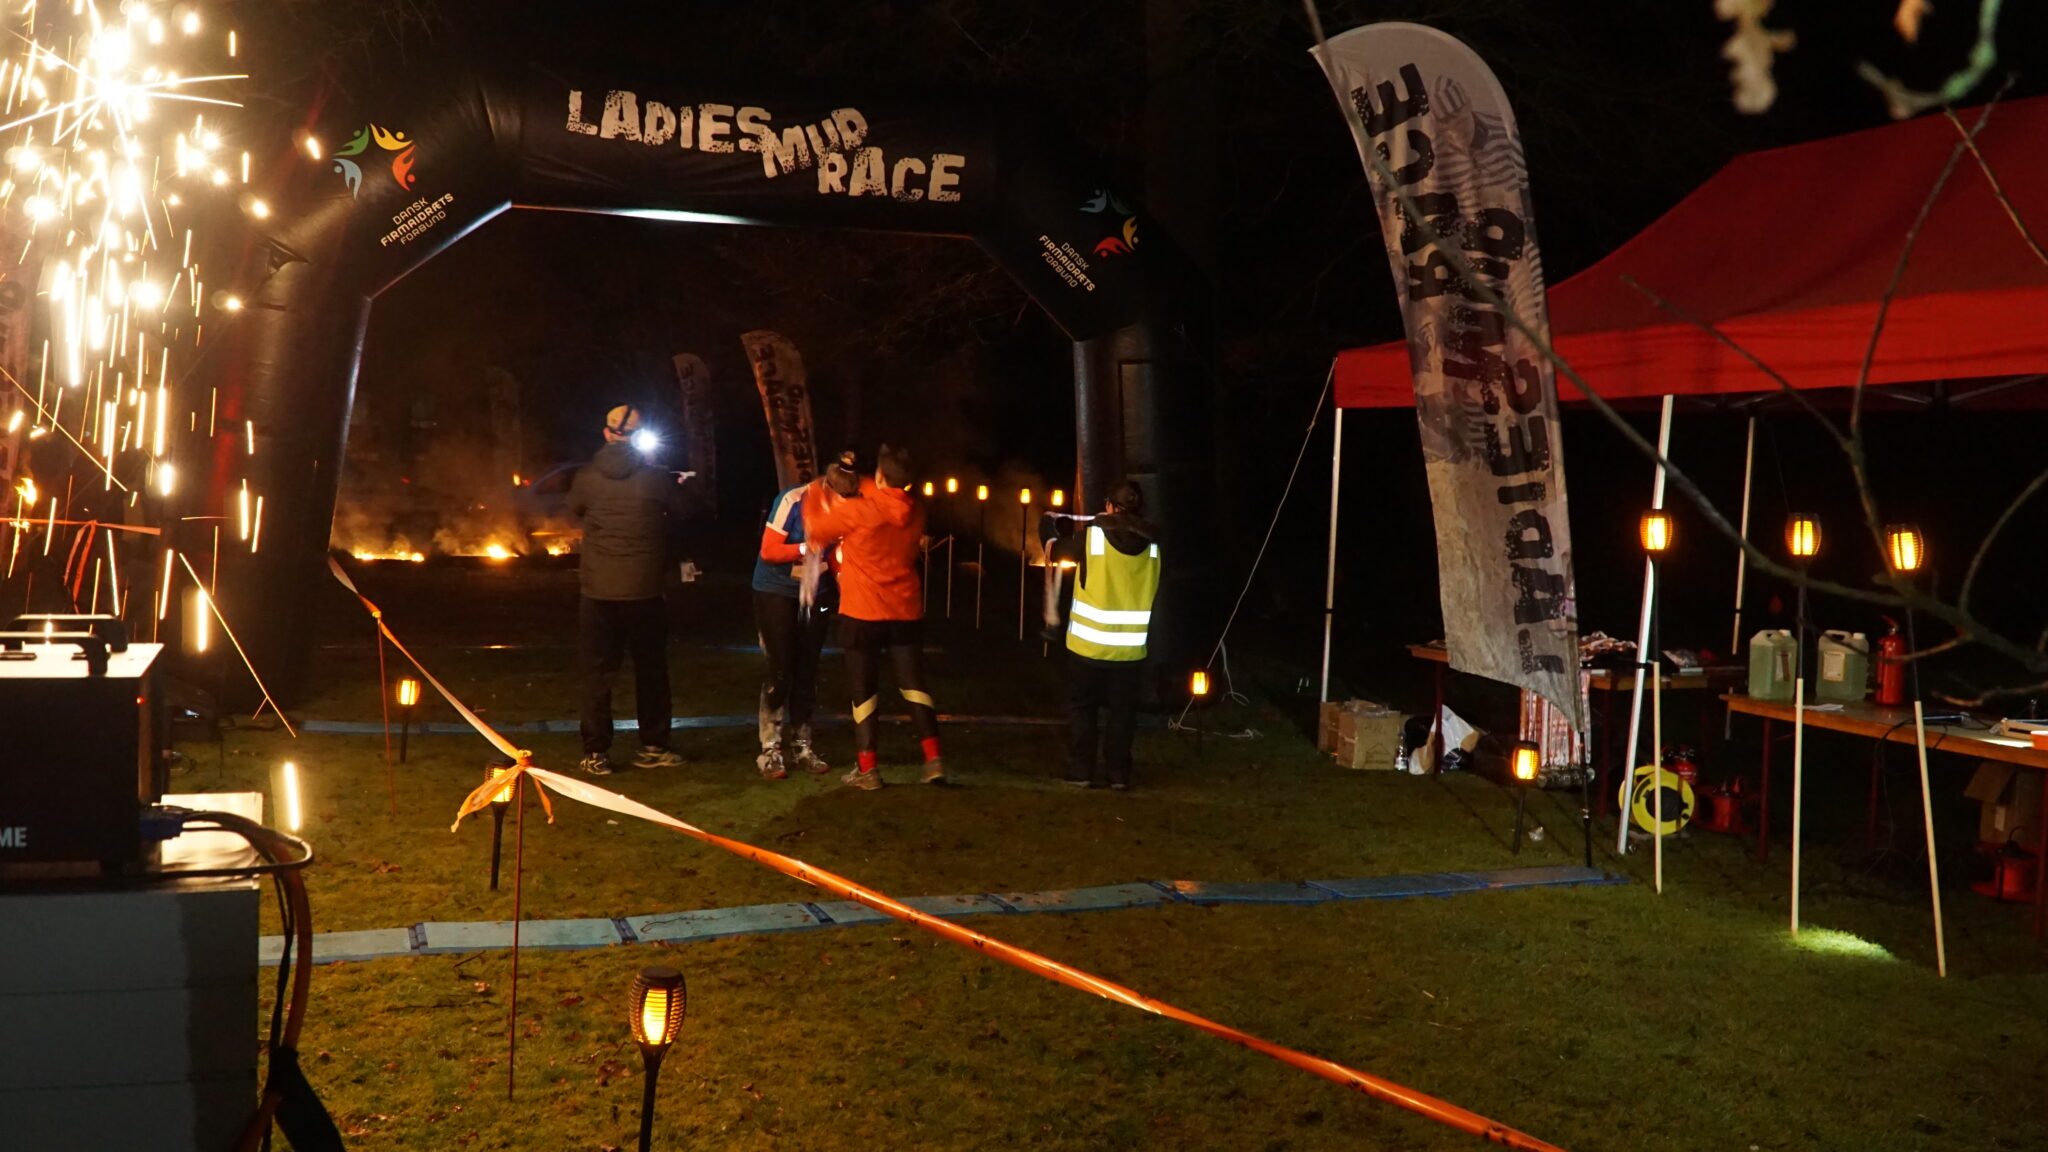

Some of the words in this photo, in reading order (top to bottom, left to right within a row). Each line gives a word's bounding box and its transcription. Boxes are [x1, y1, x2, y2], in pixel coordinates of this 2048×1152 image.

[566, 89, 773, 154] LADIES
[760, 106, 869, 179] MUD
[816, 145, 967, 203] RACE
[380, 192, 455, 248] FIRMAIDRÆTS
[392, 196, 429, 226] DANSK
[400, 210, 447, 246] FORBUND
[1041, 251, 1079, 288] FORBUND
[1060, 242, 1091, 271] DANSK
